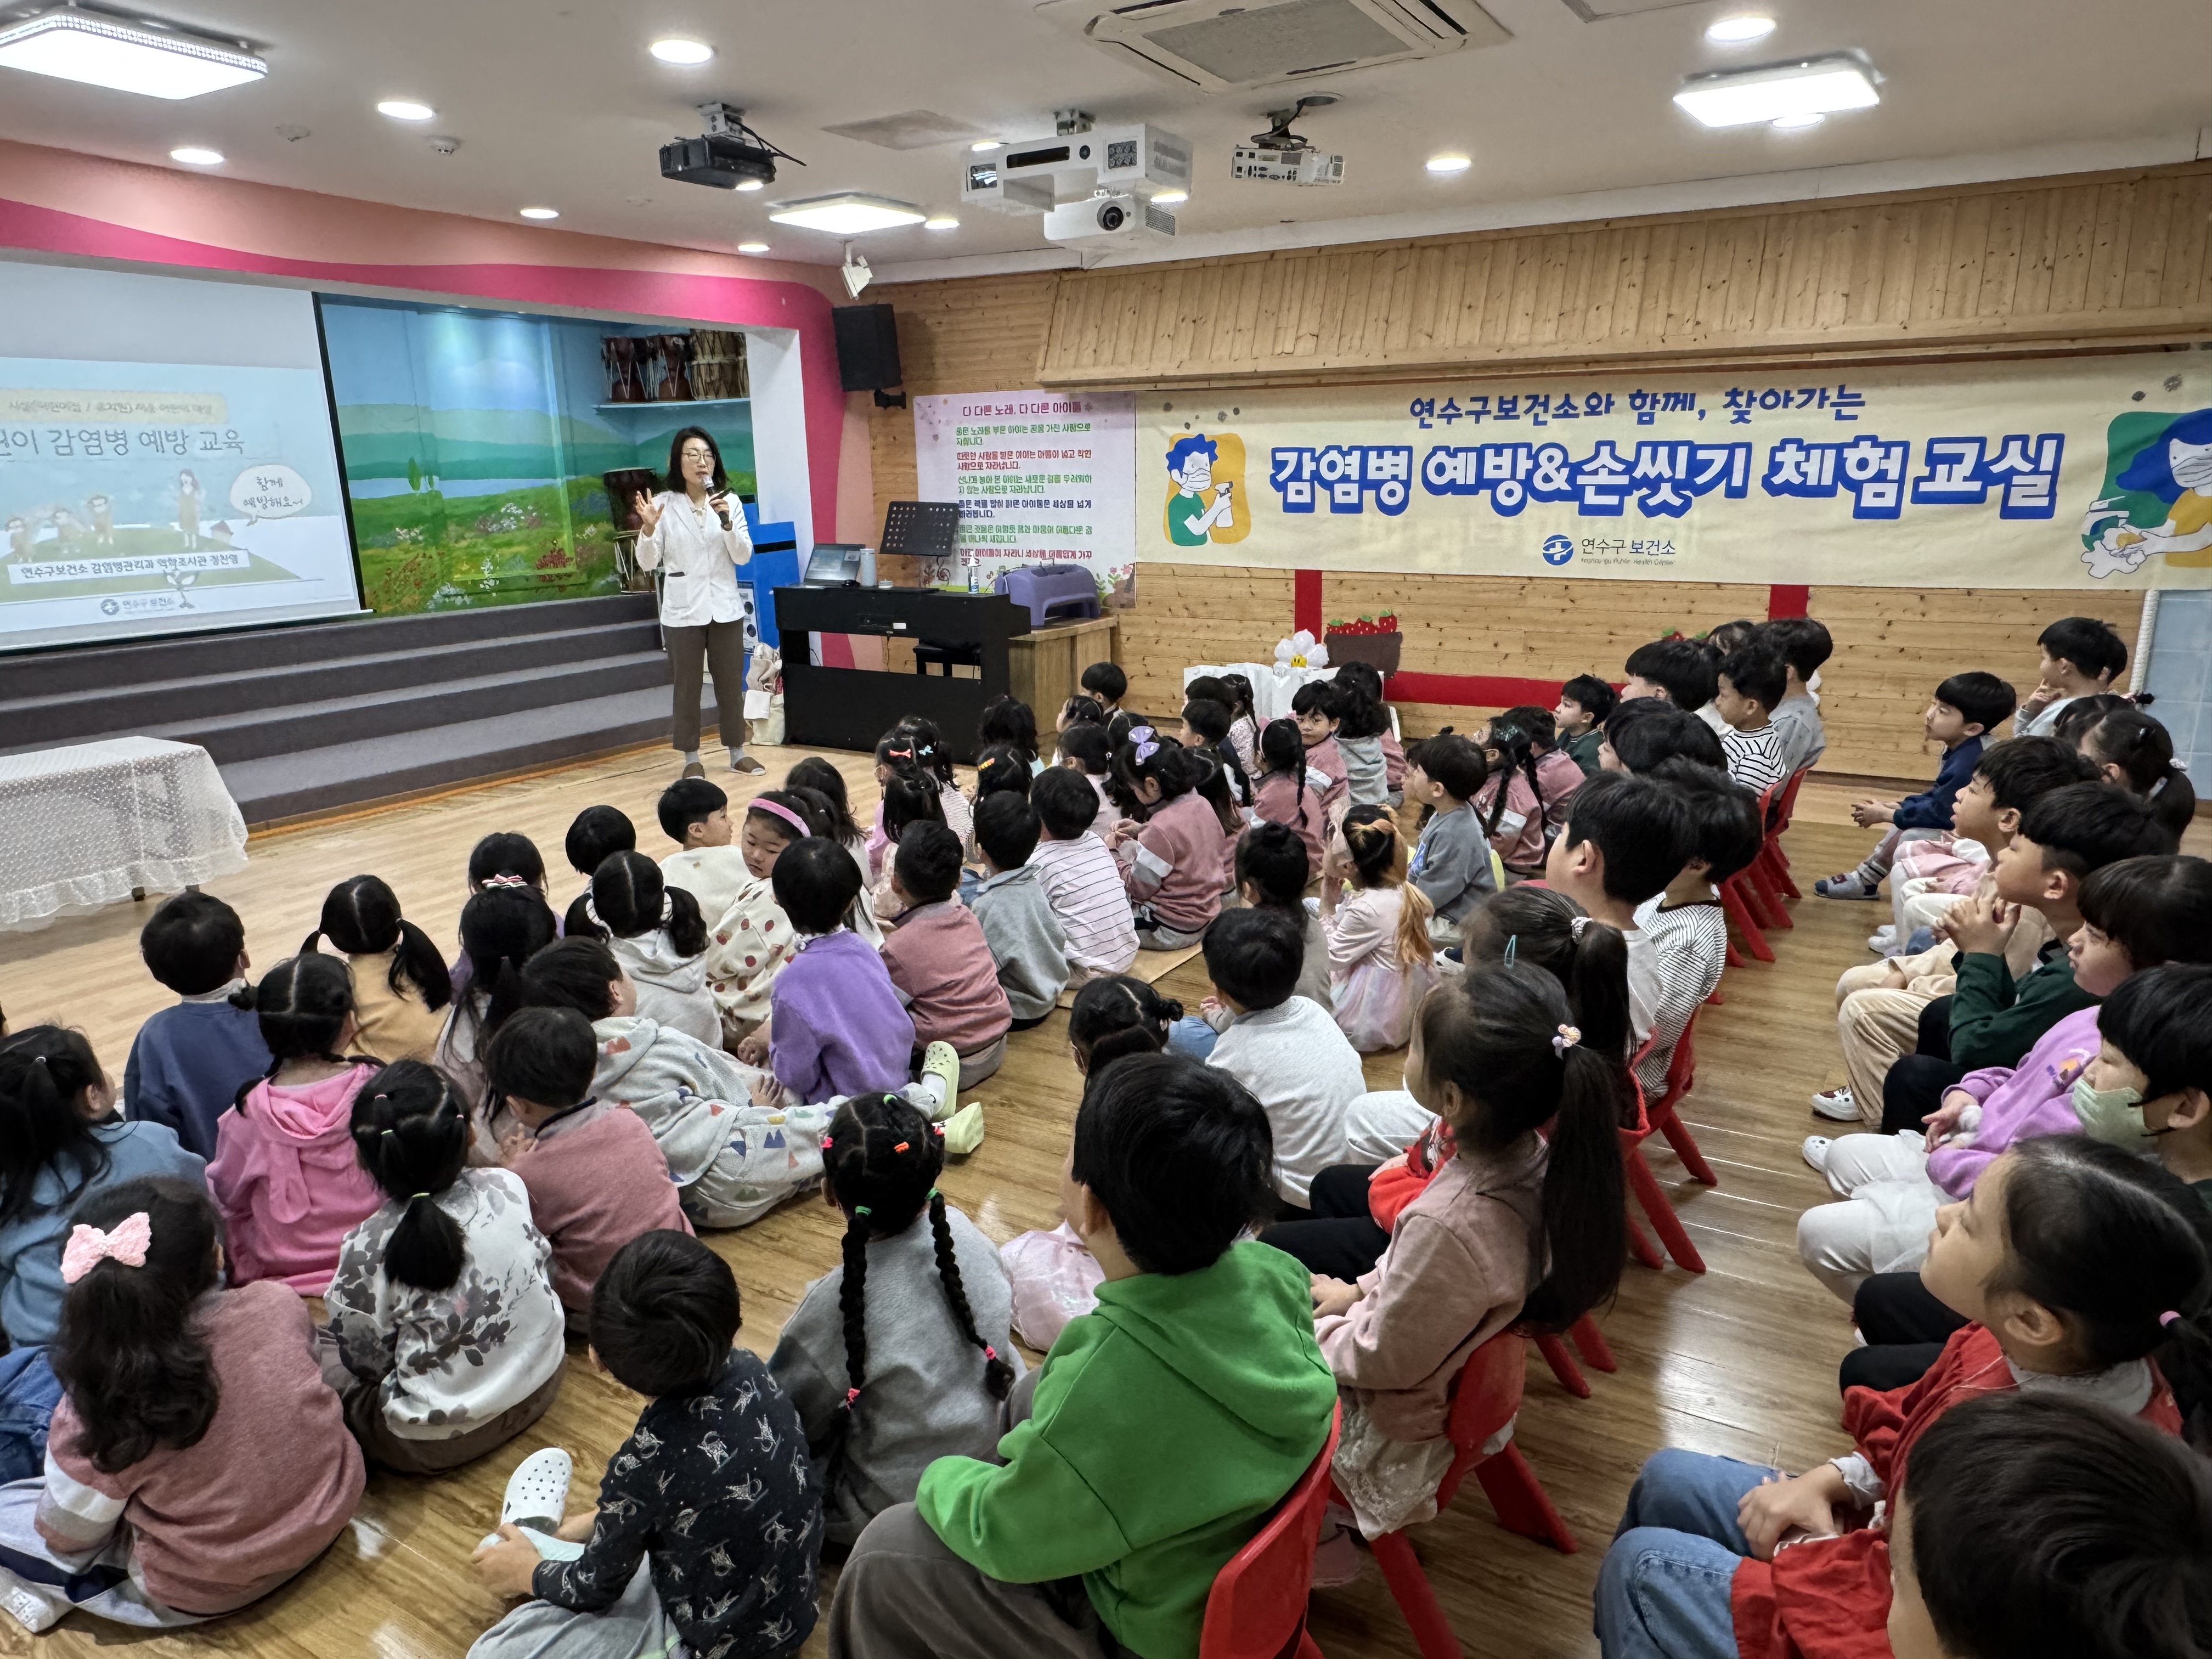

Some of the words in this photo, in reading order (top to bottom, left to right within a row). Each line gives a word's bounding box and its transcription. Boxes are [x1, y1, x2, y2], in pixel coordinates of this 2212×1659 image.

[1409, 392, 1615, 430] 연수구보건소와
[1627, 388, 1707, 425] 함께,
[1723, 384, 1866, 425] 찾아가는
[47, 429, 129, 456] 감염병
[138, 429, 189, 455] 예방
[199, 429, 246, 455] 교육
[256, 476, 284, 491] 함께
[1270, 445, 1413, 515] 감염병
[1421, 440, 1753, 517] 예방&손씻기
[1582, 538, 1627, 555] 연수구
[1629, 539, 1676, 556] 보건소
[21, 563, 89, 579] 연수구보건소
